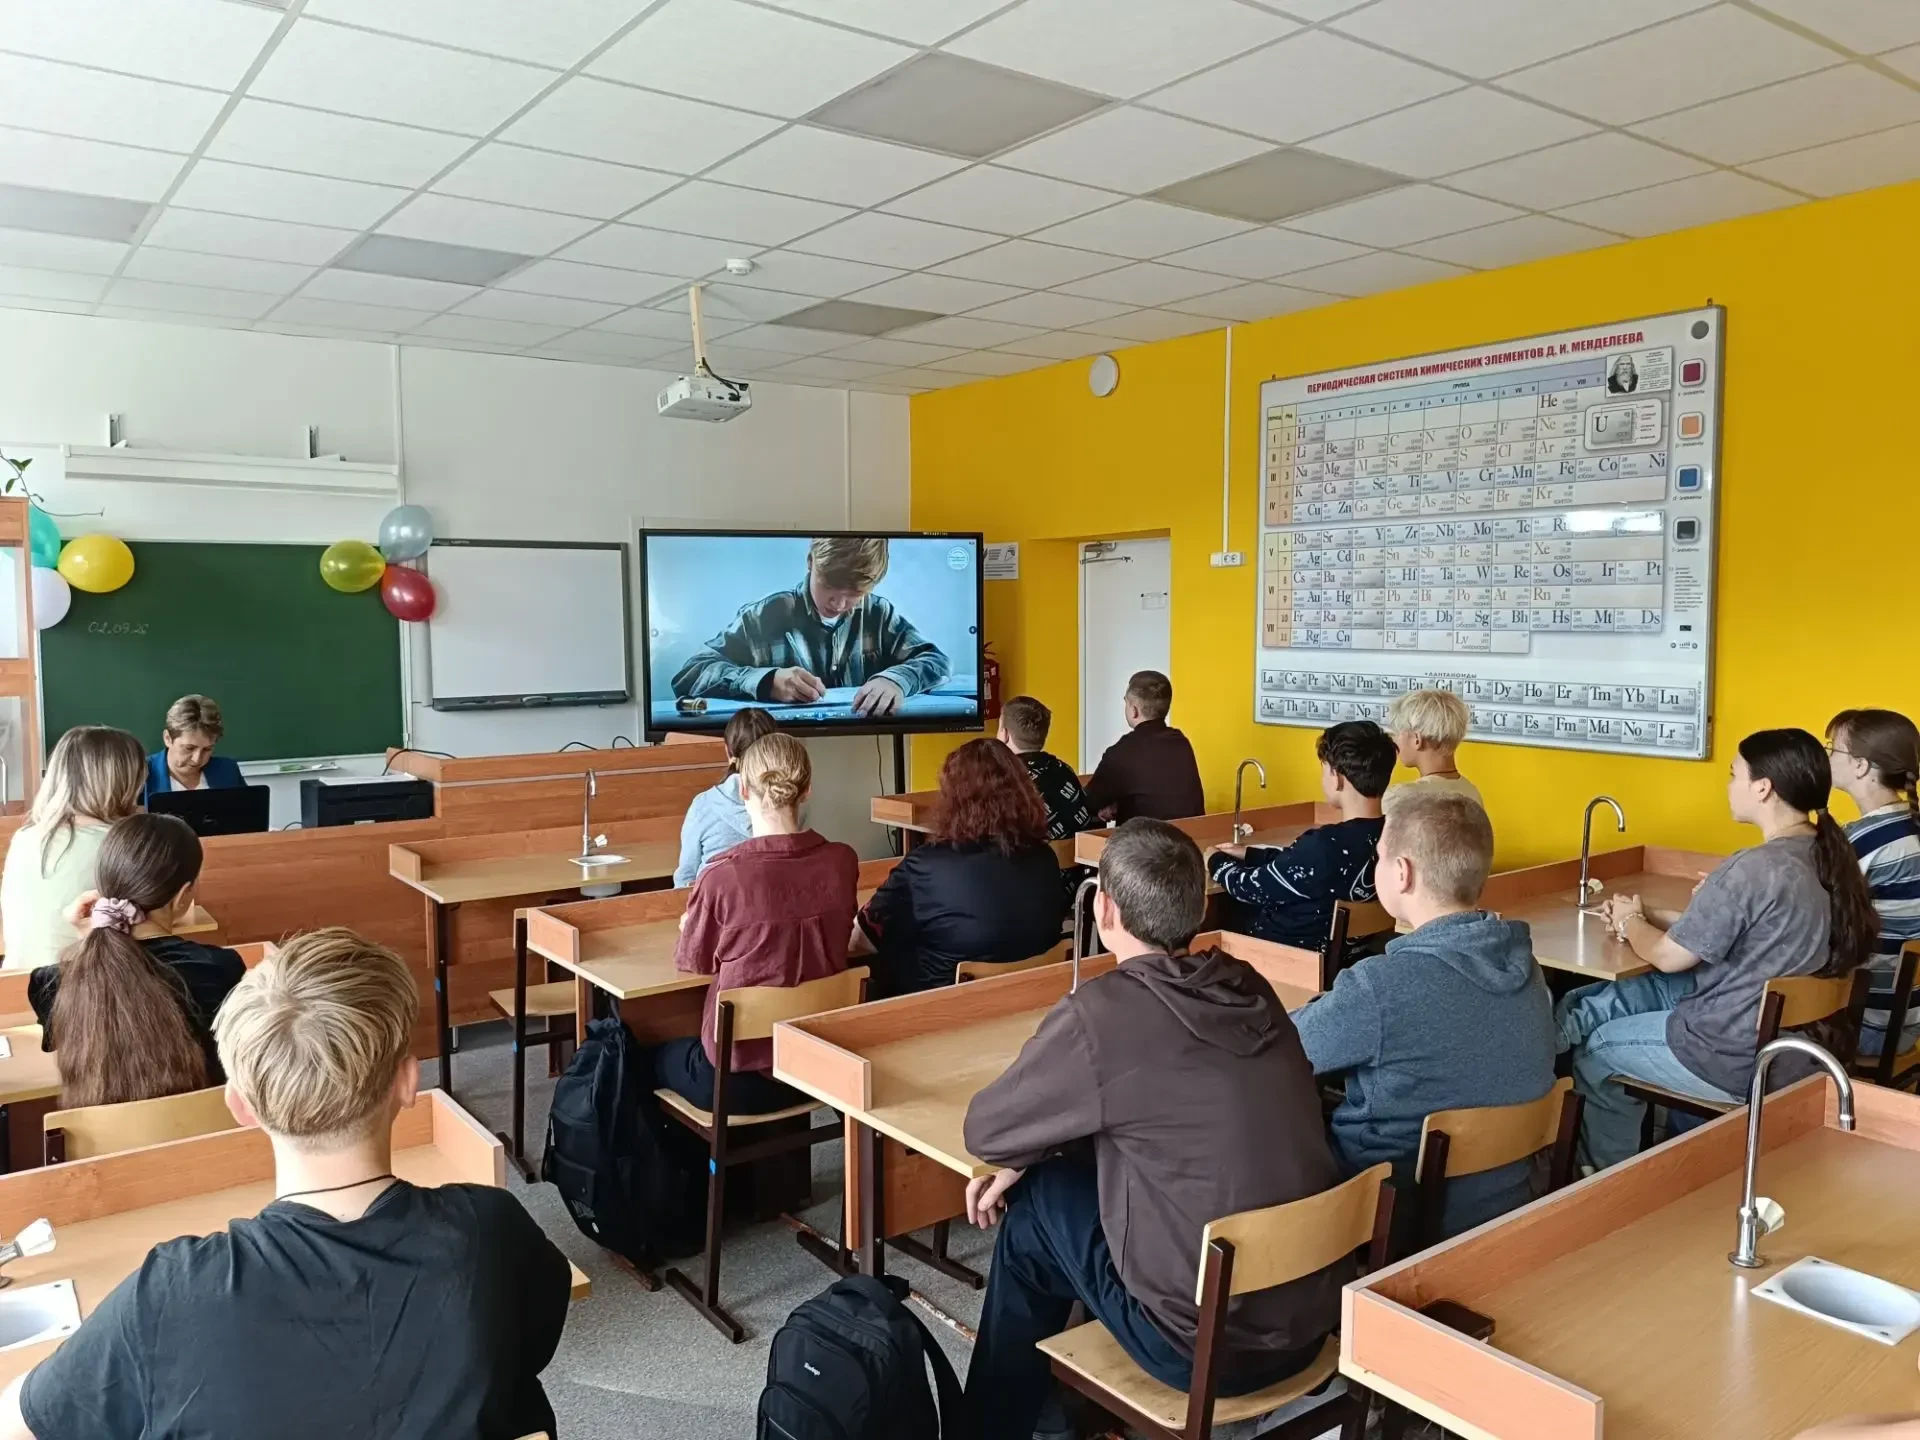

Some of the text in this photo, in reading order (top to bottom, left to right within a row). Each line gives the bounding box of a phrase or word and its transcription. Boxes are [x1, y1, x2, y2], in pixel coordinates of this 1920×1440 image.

[1307, 331, 1644, 394] ПЕРИОДИЧЕСКАЯ СИСТЕМА ХИМИЧЕСКИХ ЭЛЕМЕНТОВ Д. И. МЕНДЕЛЕЕВА
[1298, 426, 1305, 438] H
[1540, 394, 1557, 408] He
[1595, 416, 1608, 432] U
[1297, 446, 1306, 458] Li
[1326, 443, 1337, 454] Be
[1357, 439, 1364, 451] B
[1390, 434, 1399, 447] C
[1426, 430, 1436, 444] N
[1461, 426, 1472, 439] O
[1540, 417, 1556, 431] Ne
[1296, 466, 1307, 478] Na
[1325, 463, 1339, 477] Mg
[1388, 456, 1398, 468] Si
[1424, 453, 1432, 465] P
[1460, 448, 1468, 461] S
[1498, 444, 1511, 458] Cl
[1538, 440, 1554, 455] Ar
[1295, 485, 1302, 497] K
[1324, 483, 1336, 494] Ca
[1373, 478, 1385, 490] Sc
[1408, 475, 1419, 487] Ti
[1447, 471, 1455, 484] V
[1479, 468, 1493, 481] Cr
[1512, 465, 1532, 479] Mn
[1559, 461, 1574, 475] Fe
[1599, 458, 1618, 472] Co
[1649, 453, 1665, 468] Ni
[1307, 504, 1320, 516] Cu
[1338, 502, 1351, 513] Zn
[1355, 500, 1368, 512] Ga
[1387, 497, 1402, 510] Ge
[1422, 495, 1436, 508] As
[1458, 493, 1471, 505] Se
[1496, 489, 1510, 502] Br
[1536, 486, 1552, 500] Kr
[1294, 533, 1307, 545] Rb
[1323, 531, 1333, 543] Sr
[1376, 528, 1384, 540] Y
[1405, 526, 1418, 539] Zr
[1436, 524, 1453, 537] Nb
[1473, 522, 1491, 535] Mo
[1516, 520, 1530, 533] Tc
[1307, 552, 1320, 566] Ag
[1337, 550, 1351, 562] Cd
[1355, 550, 1365, 561] In
[1386, 547, 1399, 560] Sn
[1421, 547, 1434, 560] Sb
[1457, 545, 1470, 558] Te
[1494, 543, 1498, 556] I
[1534, 542, 1550, 555] Xe
[1293, 572, 1305, 583] Cs
[1324, 571, 1335, 583] Ba
[1402, 568, 1418, 580] Hf
[1440, 567, 1453, 580] Ta
[1476, 566, 1490, 579] W
[1514, 565, 1530, 578] Re
[1553, 563, 1571, 577] Os
[1602, 562, 1614, 577] Ir
[1646, 561, 1661, 576] Pt
[1307, 591, 1320, 602] Au
[1336, 590, 1351, 605] Hg
[1354, 590, 1365, 602] Tl
[1387, 589, 1400, 601] Pb
[1421, 589, 1432, 601] Bi
[1456, 588, 1470, 601] Po
[1494, 588, 1506, 600] At
[1533, 587, 1551, 600] Rn
[1267, 624, 1275, 632] VII
[1293, 610, 1304, 622] Fr
[1323, 610, 1336, 622] Ra
[1403, 610, 1417, 622] Rf
[1436, 610, 1453, 623] Db
[1474, 610, 1489, 626] Sg
[1512, 610, 1528, 623] Bh
[1552, 610, 1570, 624] Hs
[1594, 610, 1612, 624] Mt
[1641, 610, 1660, 624] Ds
[1280, 630, 1469, 645] 11 Rg Cn Fl Lv
[1263, 672, 1679, 705] La Ce Pr Nd Pm Sm Eu Gd Tb Dy Ho Er Tm Yb Lu
[1262, 698, 1274, 710] Ac
[1285, 699, 1298, 711] Th
[1308, 701, 1318, 713] Pa
[1331, 702, 1340, 714] U
[1356, 703, 1371, 718] Np
[1493, 712, 1508, 727] Cf
[1524, 714, 1539, 729] Es
[1556, 717, 1576, 732] Fm
[1589, 719, 1610, 734] Md
[1623, 721, 1642, 737] No
[1658, 723, 1676, 739] Lr
[1060, 781, 1077, 799] GAP
[1073, 806, 1089, 825] GAP
